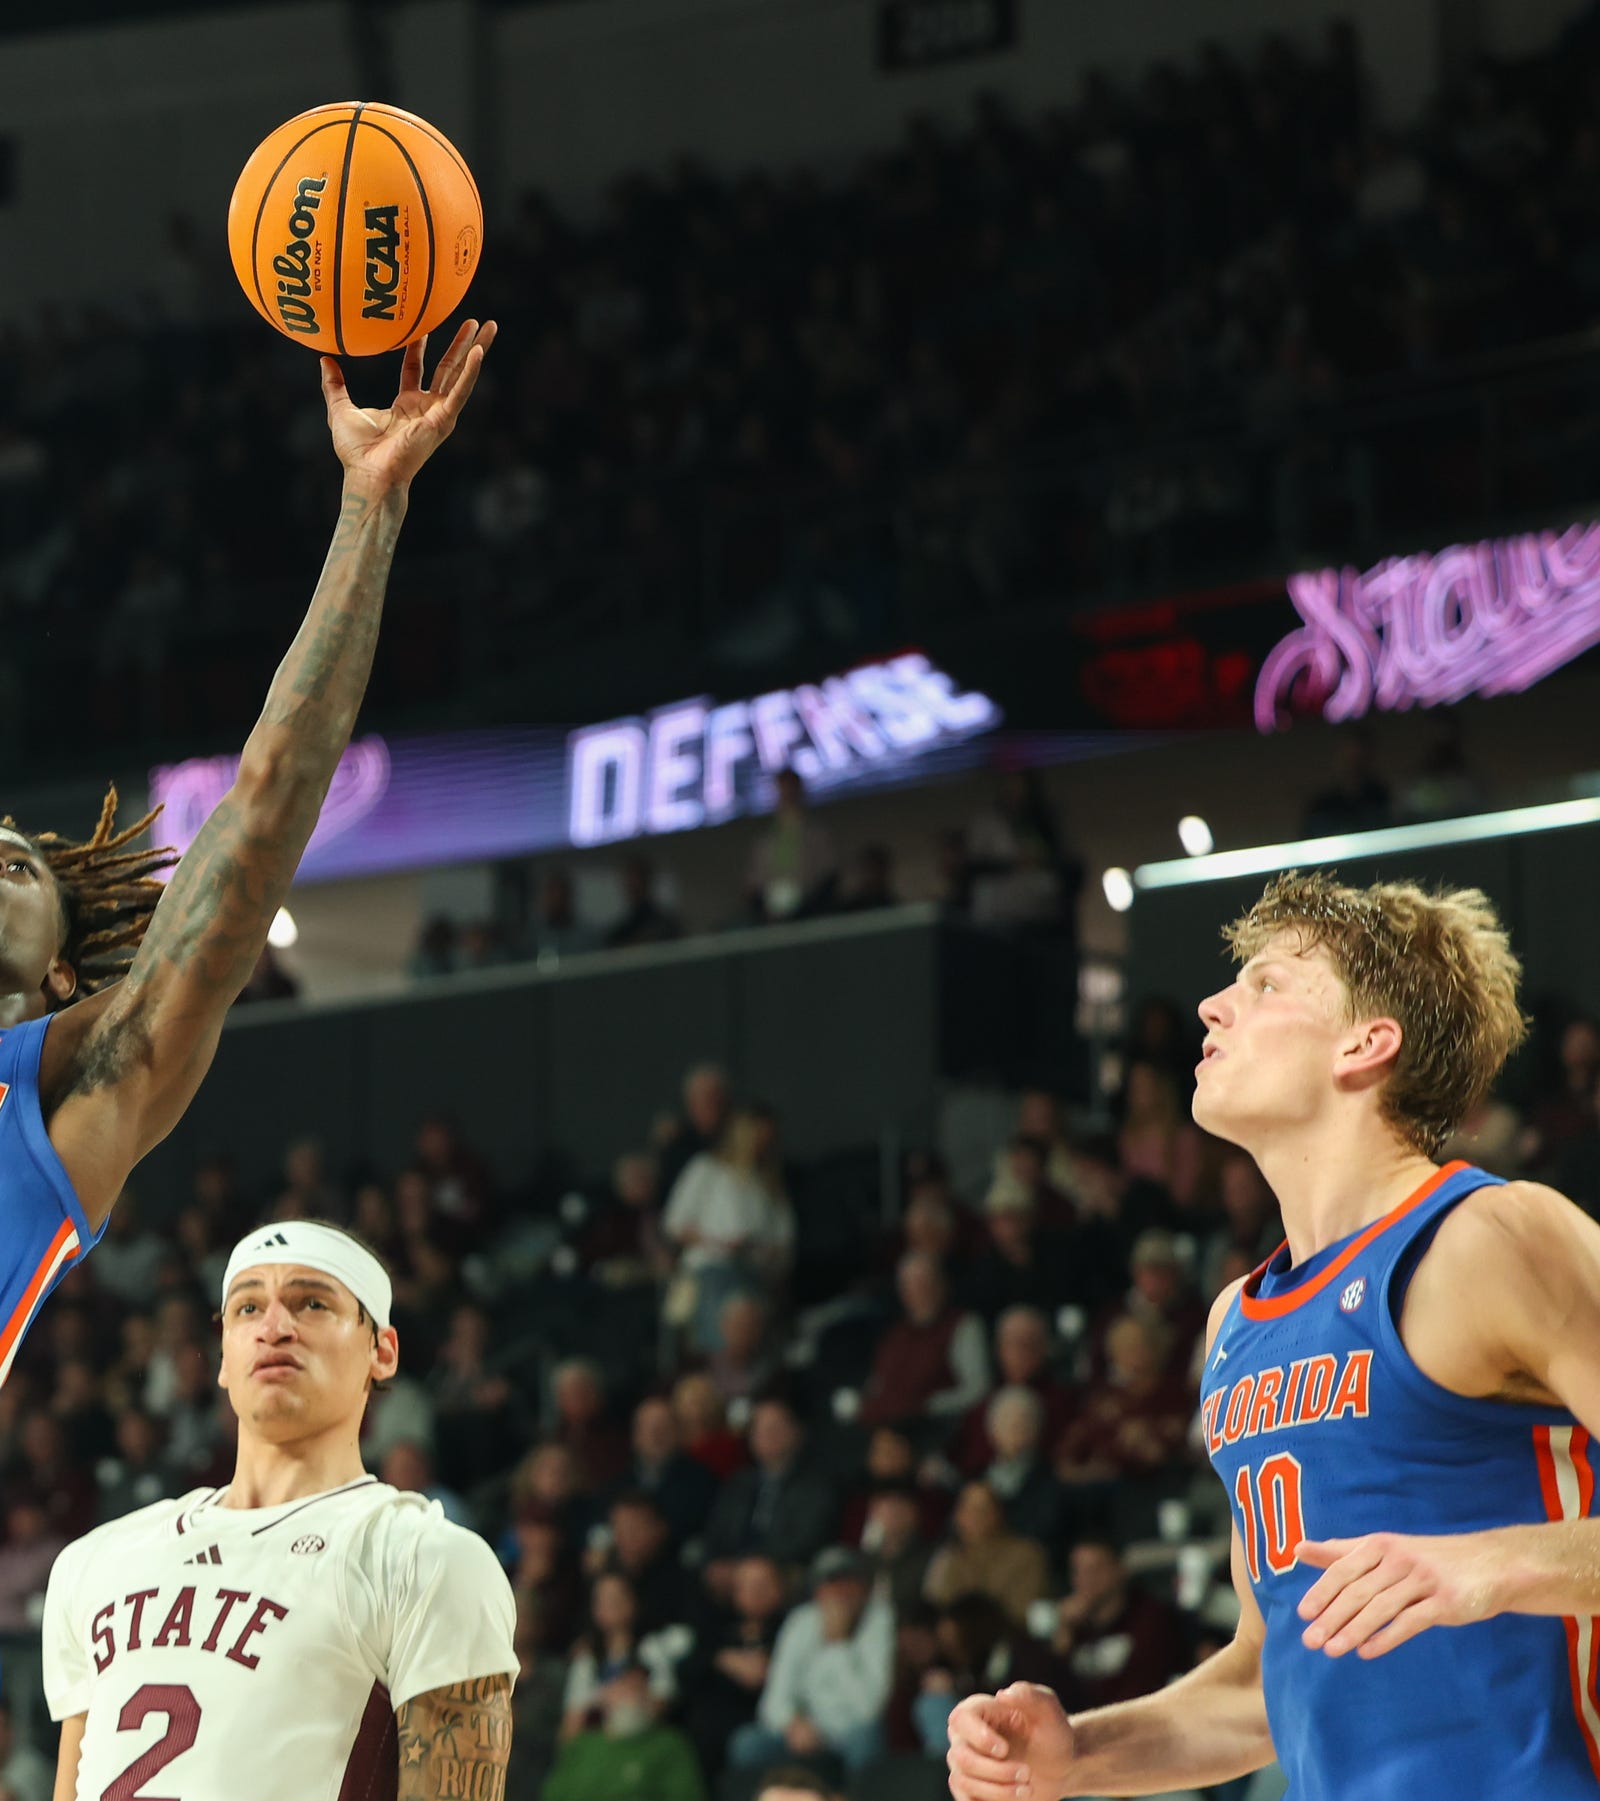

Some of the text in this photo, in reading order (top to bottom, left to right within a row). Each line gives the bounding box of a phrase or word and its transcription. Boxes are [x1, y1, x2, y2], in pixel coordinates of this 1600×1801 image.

[273, 176, 327, 335] Wilson
[314, 240, 323, 291] EVO NXT
[362, 204, 400, 321] NCAA
[569, 653, 1001, 848] DEFENSE
[1341, 1278, 1366, 1311] SEC
[1235, 1451, 1306, 1584] 10
[92, 1586, 289, 1676] STATE
[99, 1683, 202, 1801] 2
